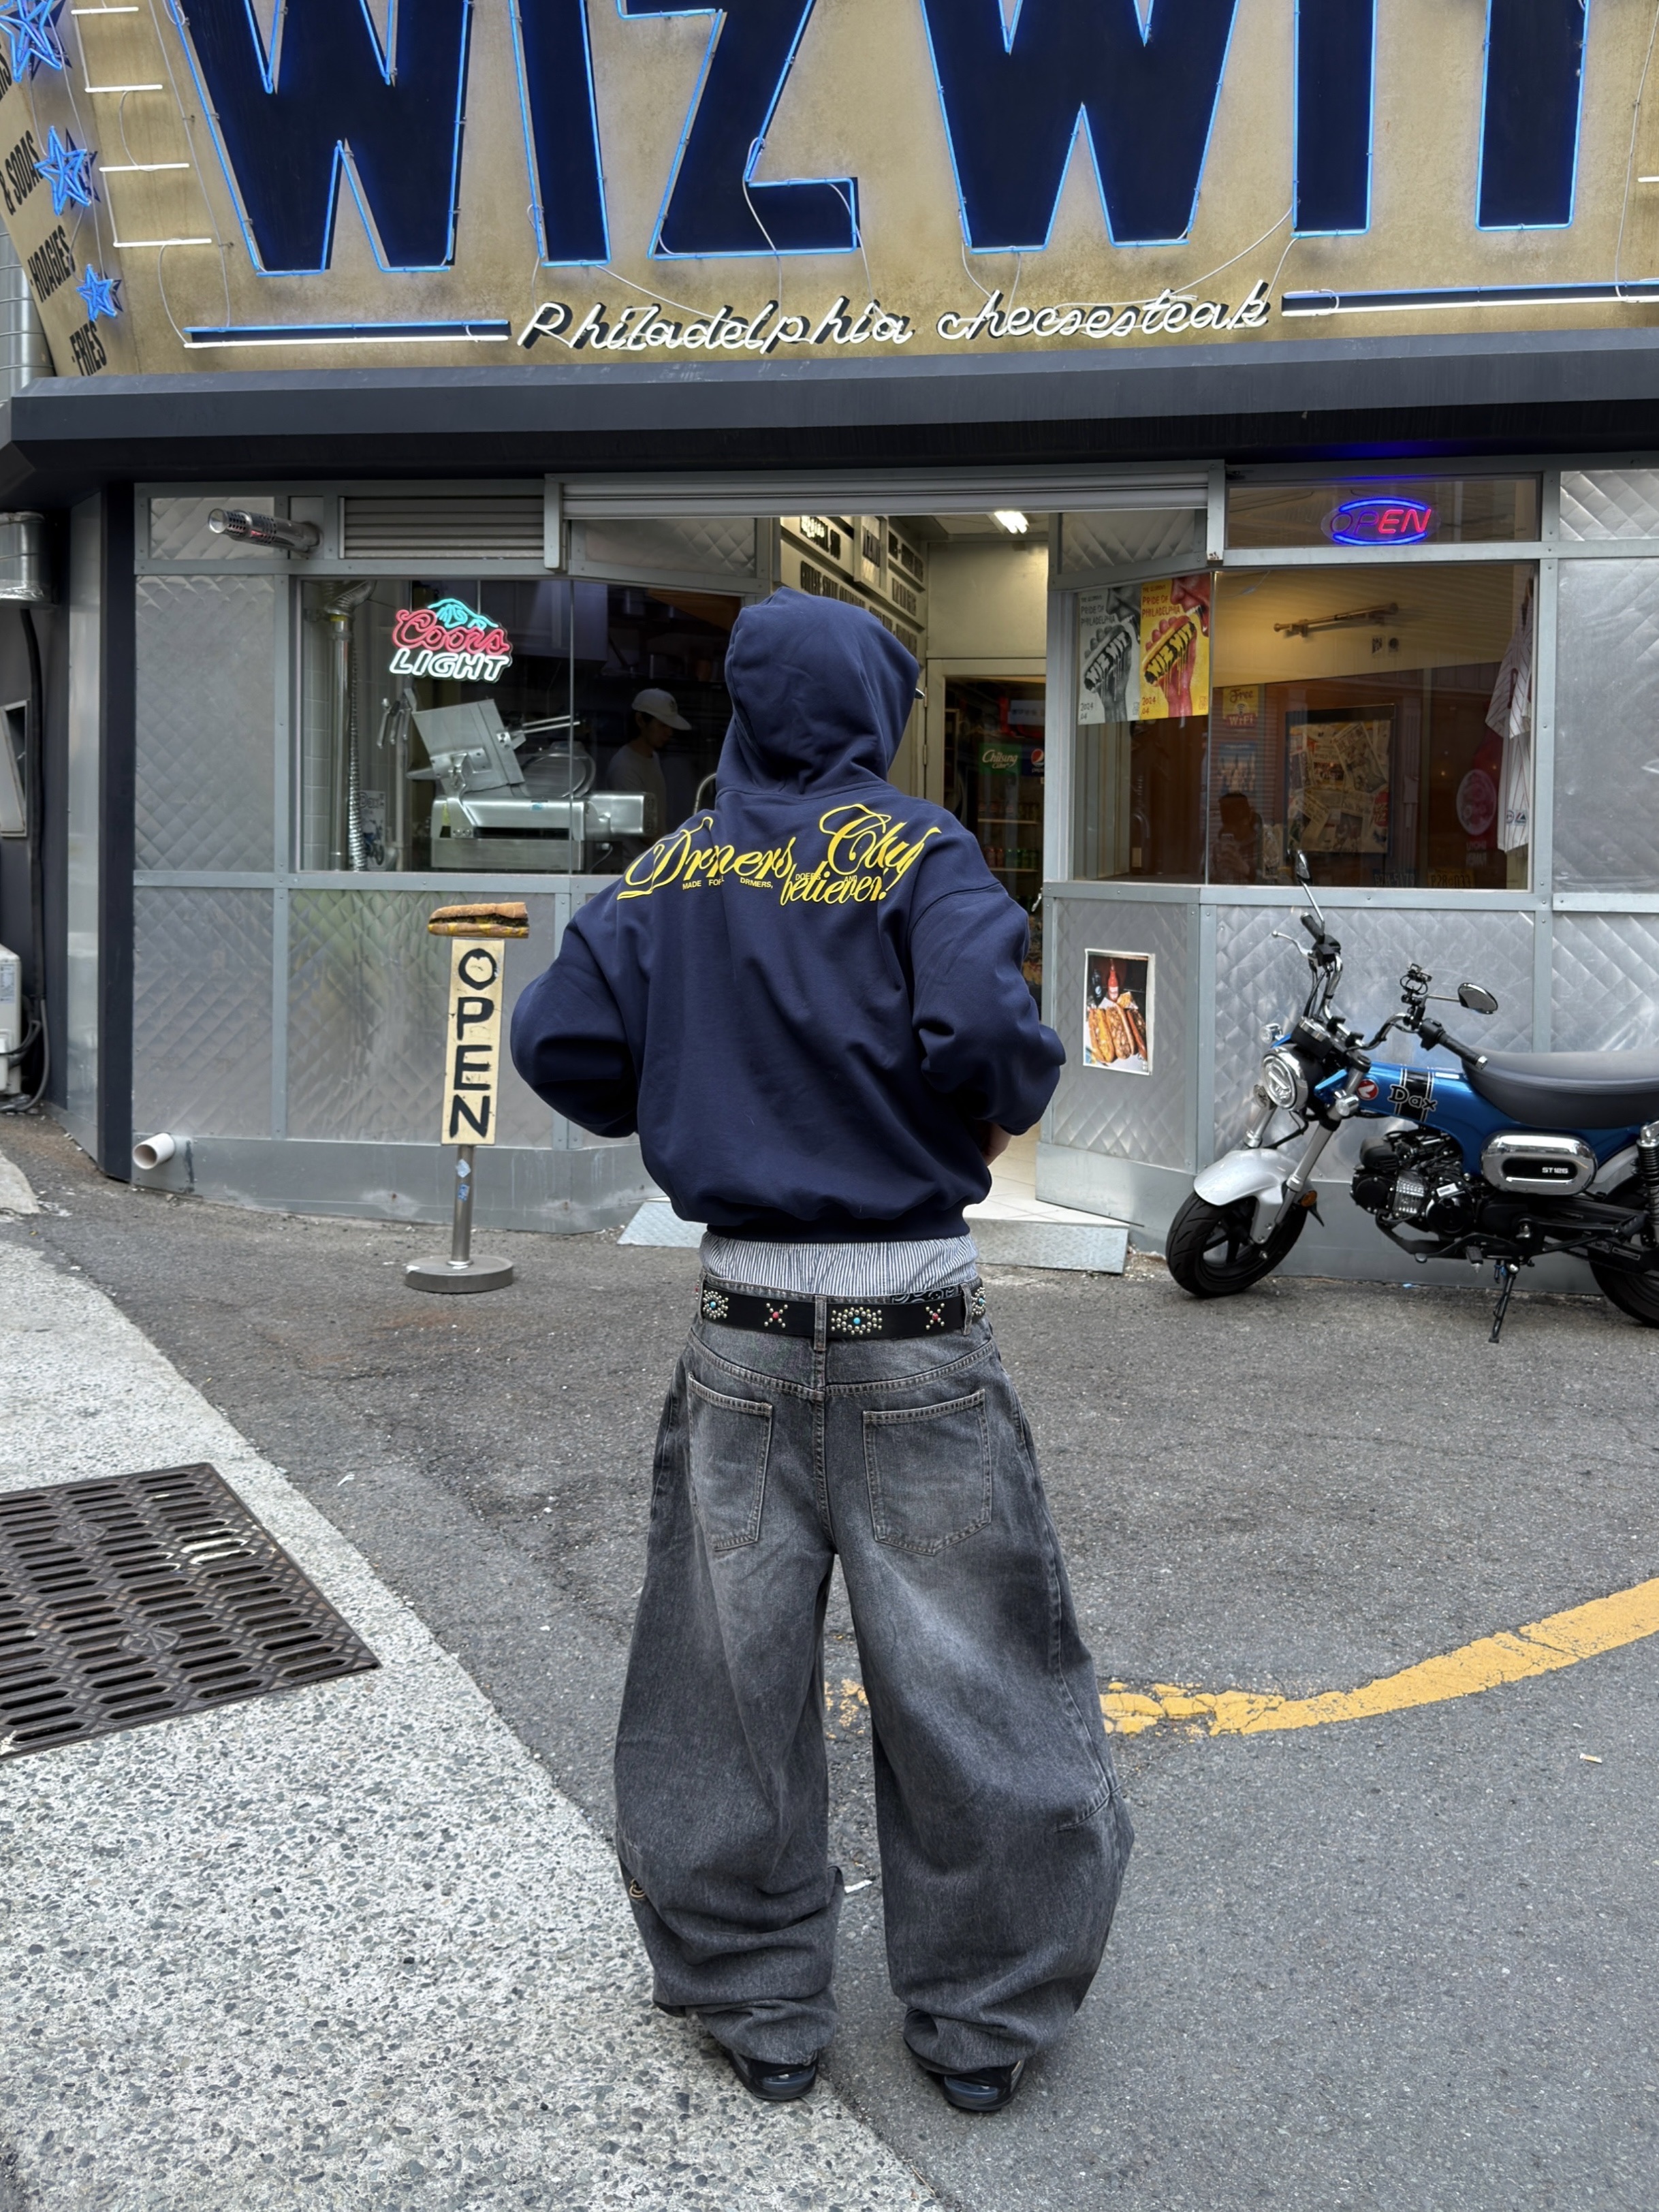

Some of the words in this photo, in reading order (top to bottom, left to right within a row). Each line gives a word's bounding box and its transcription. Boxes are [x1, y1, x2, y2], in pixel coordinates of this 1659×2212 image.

[5, 129, 44, 206] SODAS
[27, 225, 76, 303] HOAGIES
[69, 320, 107, 376] FRIES
[1330, 508, 1432, 537] OPEN
[1142, 596, 1160, 605] PRIDE
[1160, 595, 1169, 603] OF
[1142, 605, 1180, 618] PHILADELPHIA
[392, 609, 511, 657] Coors
[388, 646, 511, 682] LIGHT
[1080, 703, 1094, 712] 2024
[1141, 696, 1156, 706] 2024
[1229, 688, 1254, 704] Free
[682, 879, 702, 890] MADE
[740, 876, 774, 889] DRMERS,
[449, 947, 499, 1139] OPEN
[1387, 1084, 1438, 1112] Dax
